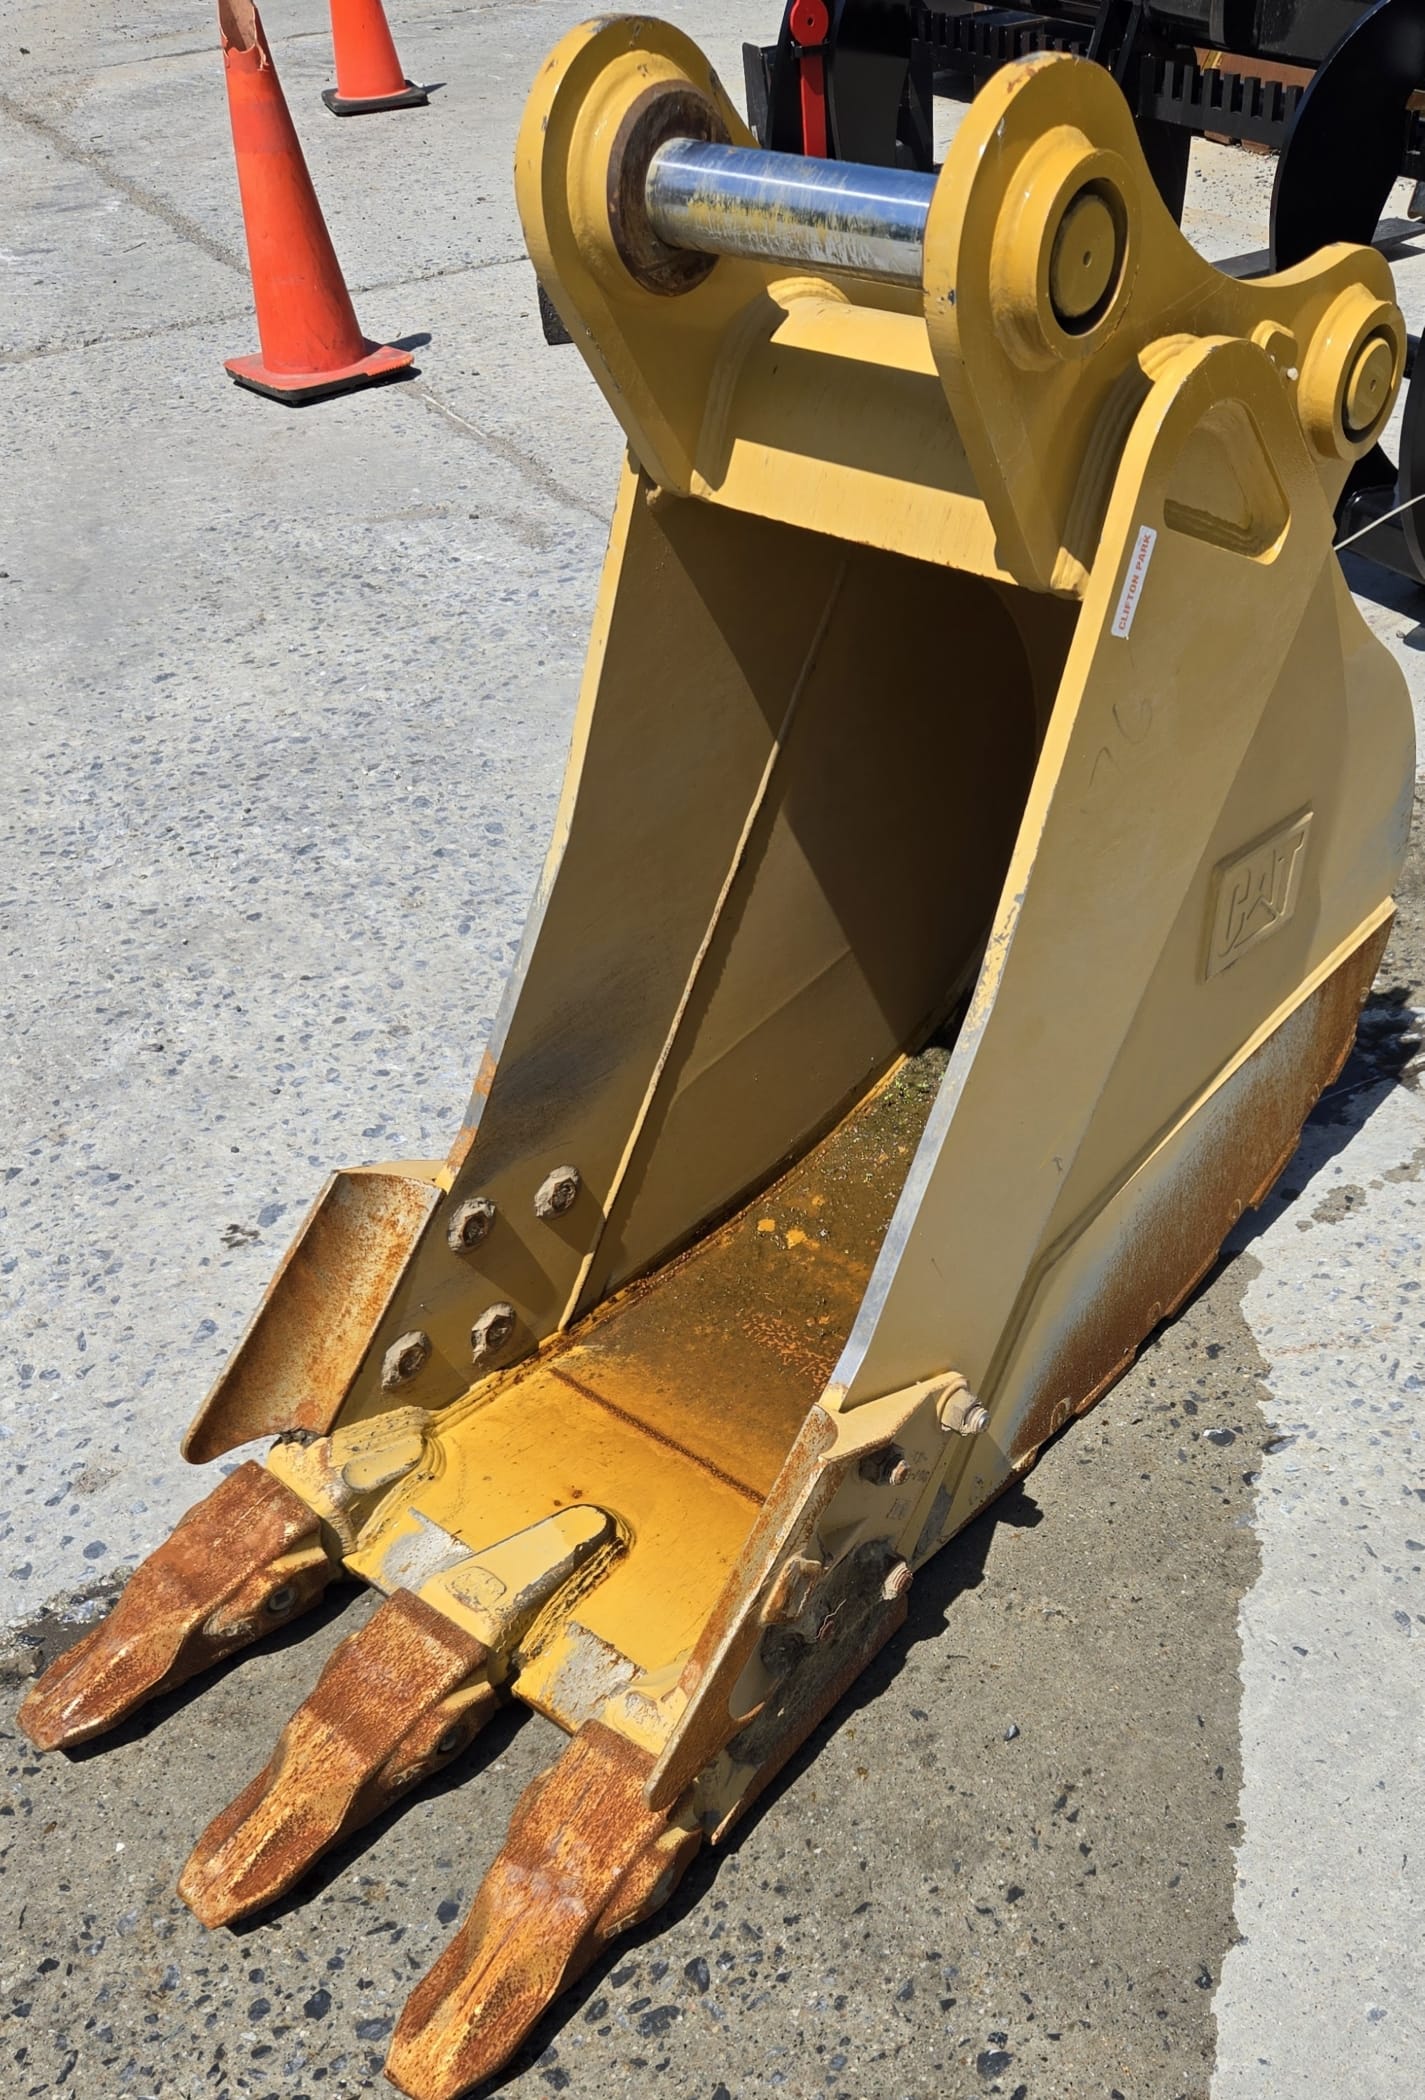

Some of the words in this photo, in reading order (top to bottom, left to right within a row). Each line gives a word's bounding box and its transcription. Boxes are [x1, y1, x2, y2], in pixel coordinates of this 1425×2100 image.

[1118, 574, 1140, 630] CLIFTON
[1135, 533, 1151, 571] PARK
[1216, 829, 1305, 958] CAT
